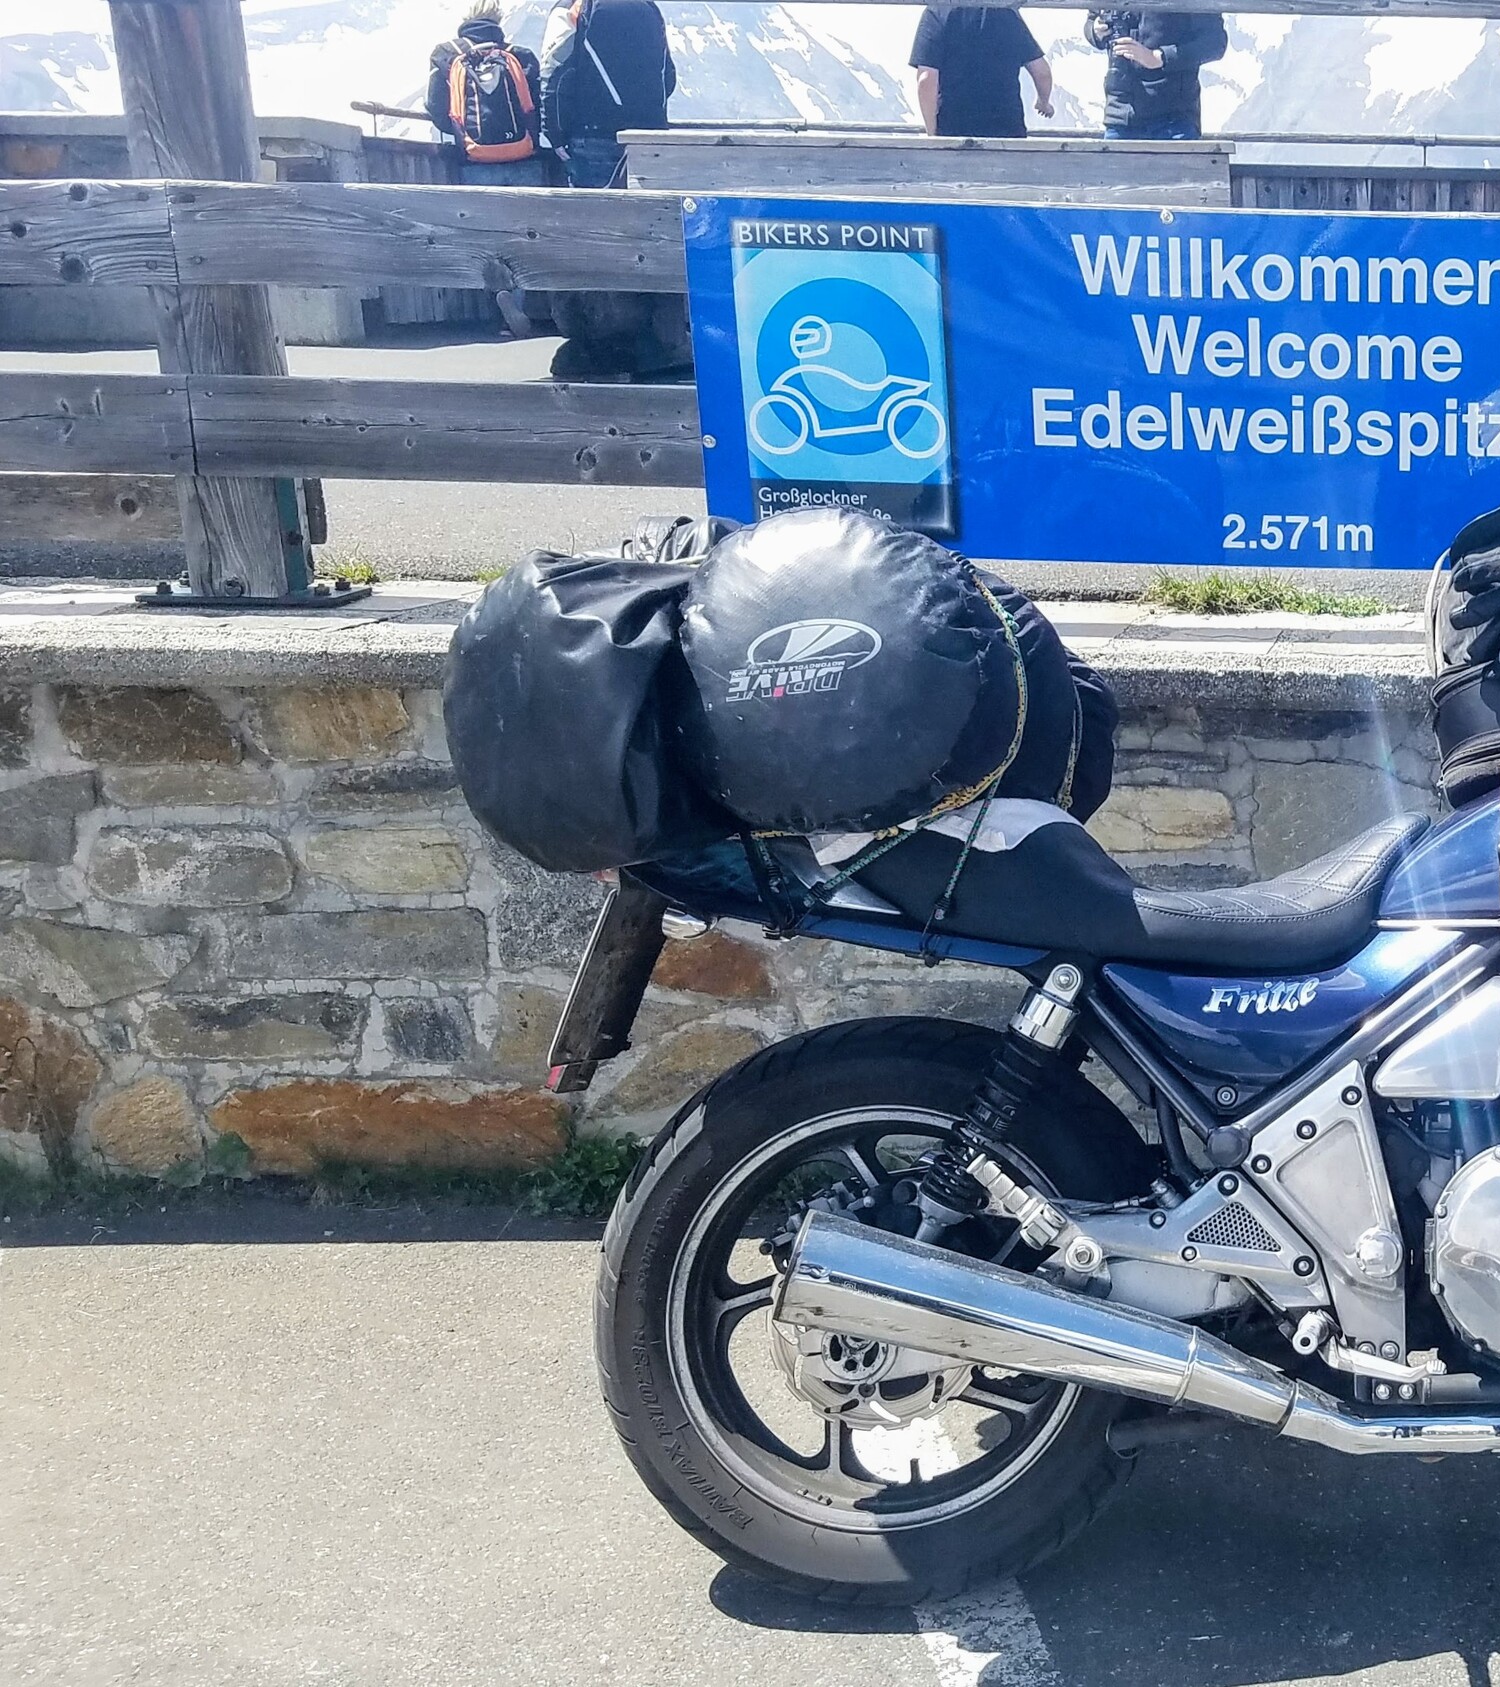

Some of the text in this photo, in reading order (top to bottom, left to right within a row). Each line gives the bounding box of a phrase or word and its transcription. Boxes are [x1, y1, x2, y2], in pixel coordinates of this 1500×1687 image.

[739, 222, 930, 249] BIKERS POINT
[1132, 314, 1463, 382] Welcome
[758, 486, 868, 507] Großglockner
[1222, 513, 1374, 552] 2.571m
[1201, 977, 1320, 1015] Fritze
